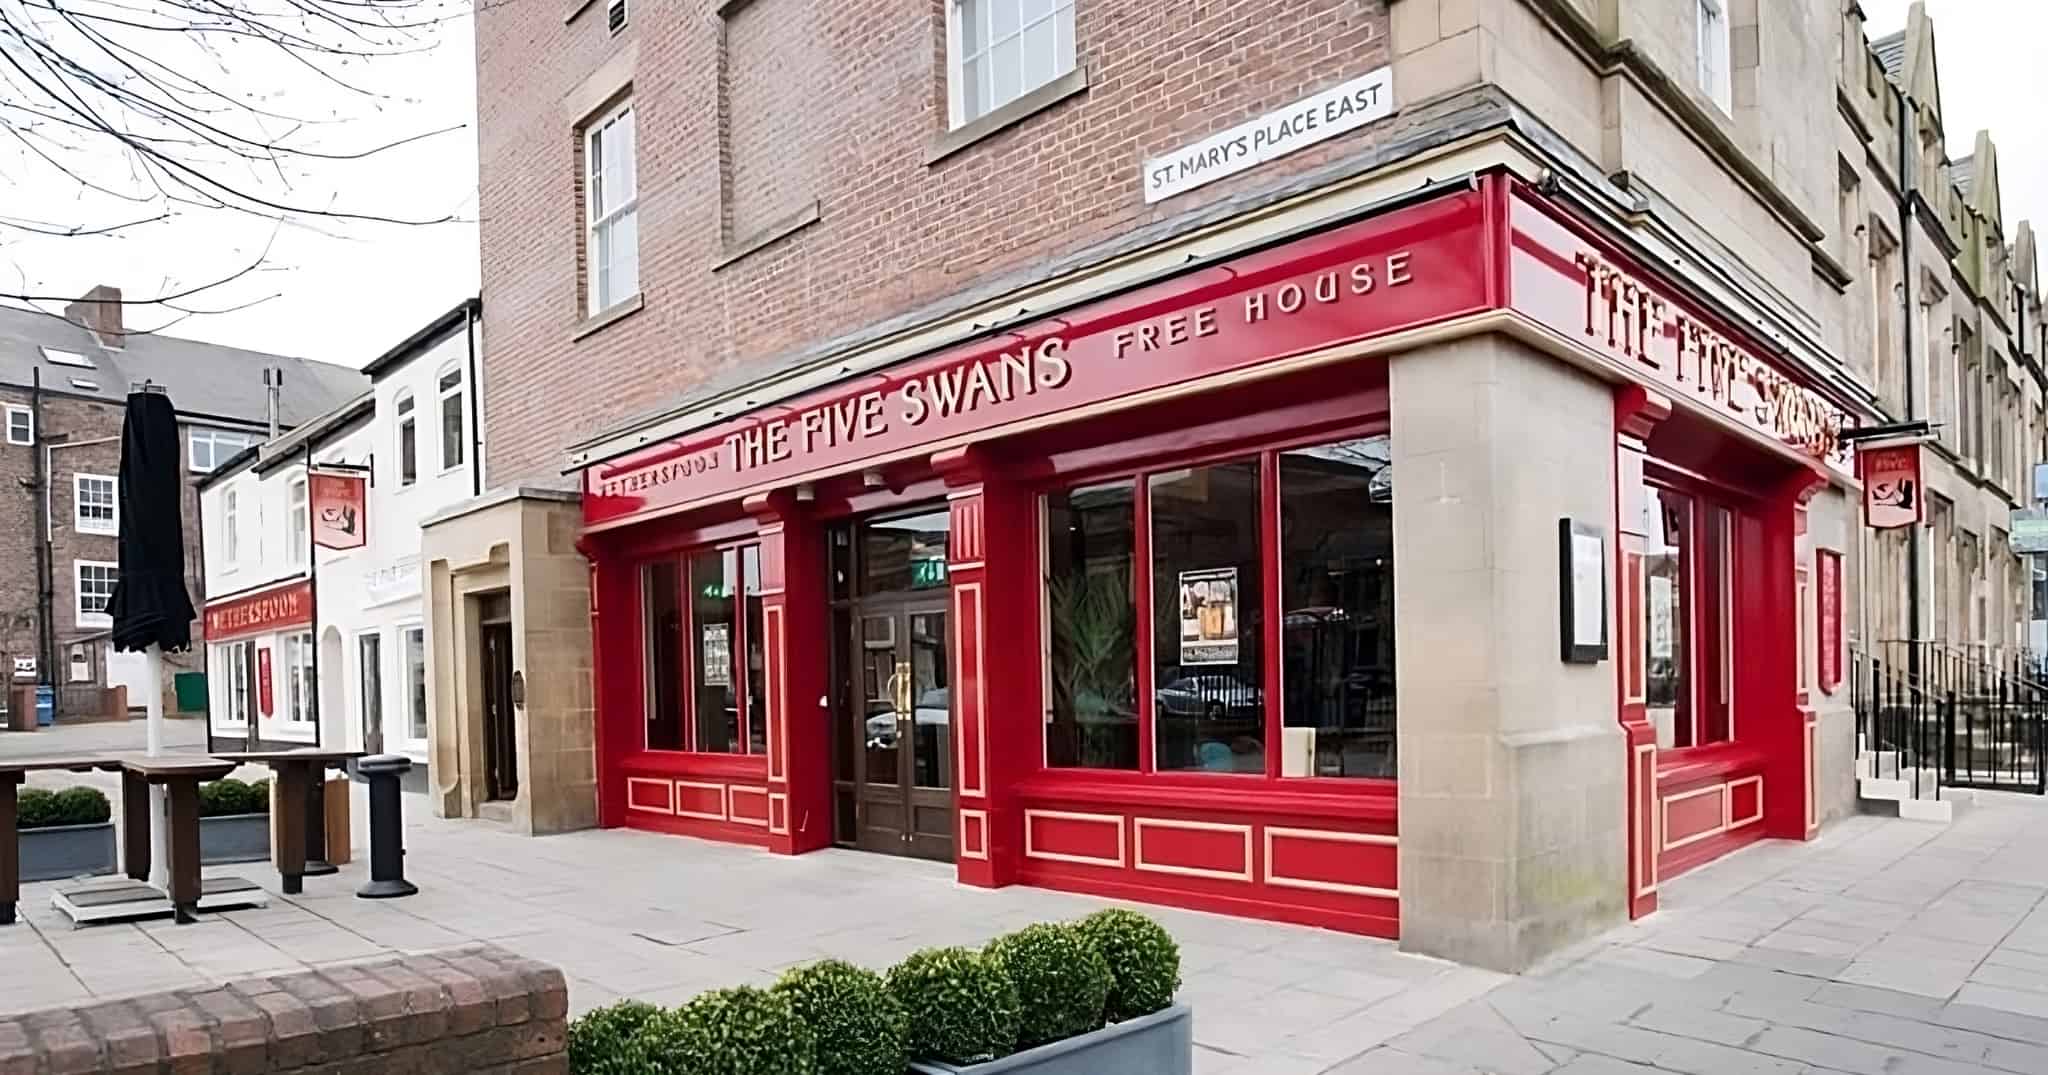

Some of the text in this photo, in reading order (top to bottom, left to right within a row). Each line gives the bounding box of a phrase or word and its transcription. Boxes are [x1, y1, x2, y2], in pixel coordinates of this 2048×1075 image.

[1179, 136, 1248, 177] MARY'S
[1254, 108, 1318, 152] PLACE
[1325, 82, 1383, 122] EAST
[726, 420, 793, 473] THE
[800, 391, 889, 453] FIVE
[901, 336, 1073, 426] SWANS
[1112, 307, 1219, 360] FREE
[1244, 251, 1414, 323] HOUSE
[1575, 252, 1667, 371] THE
